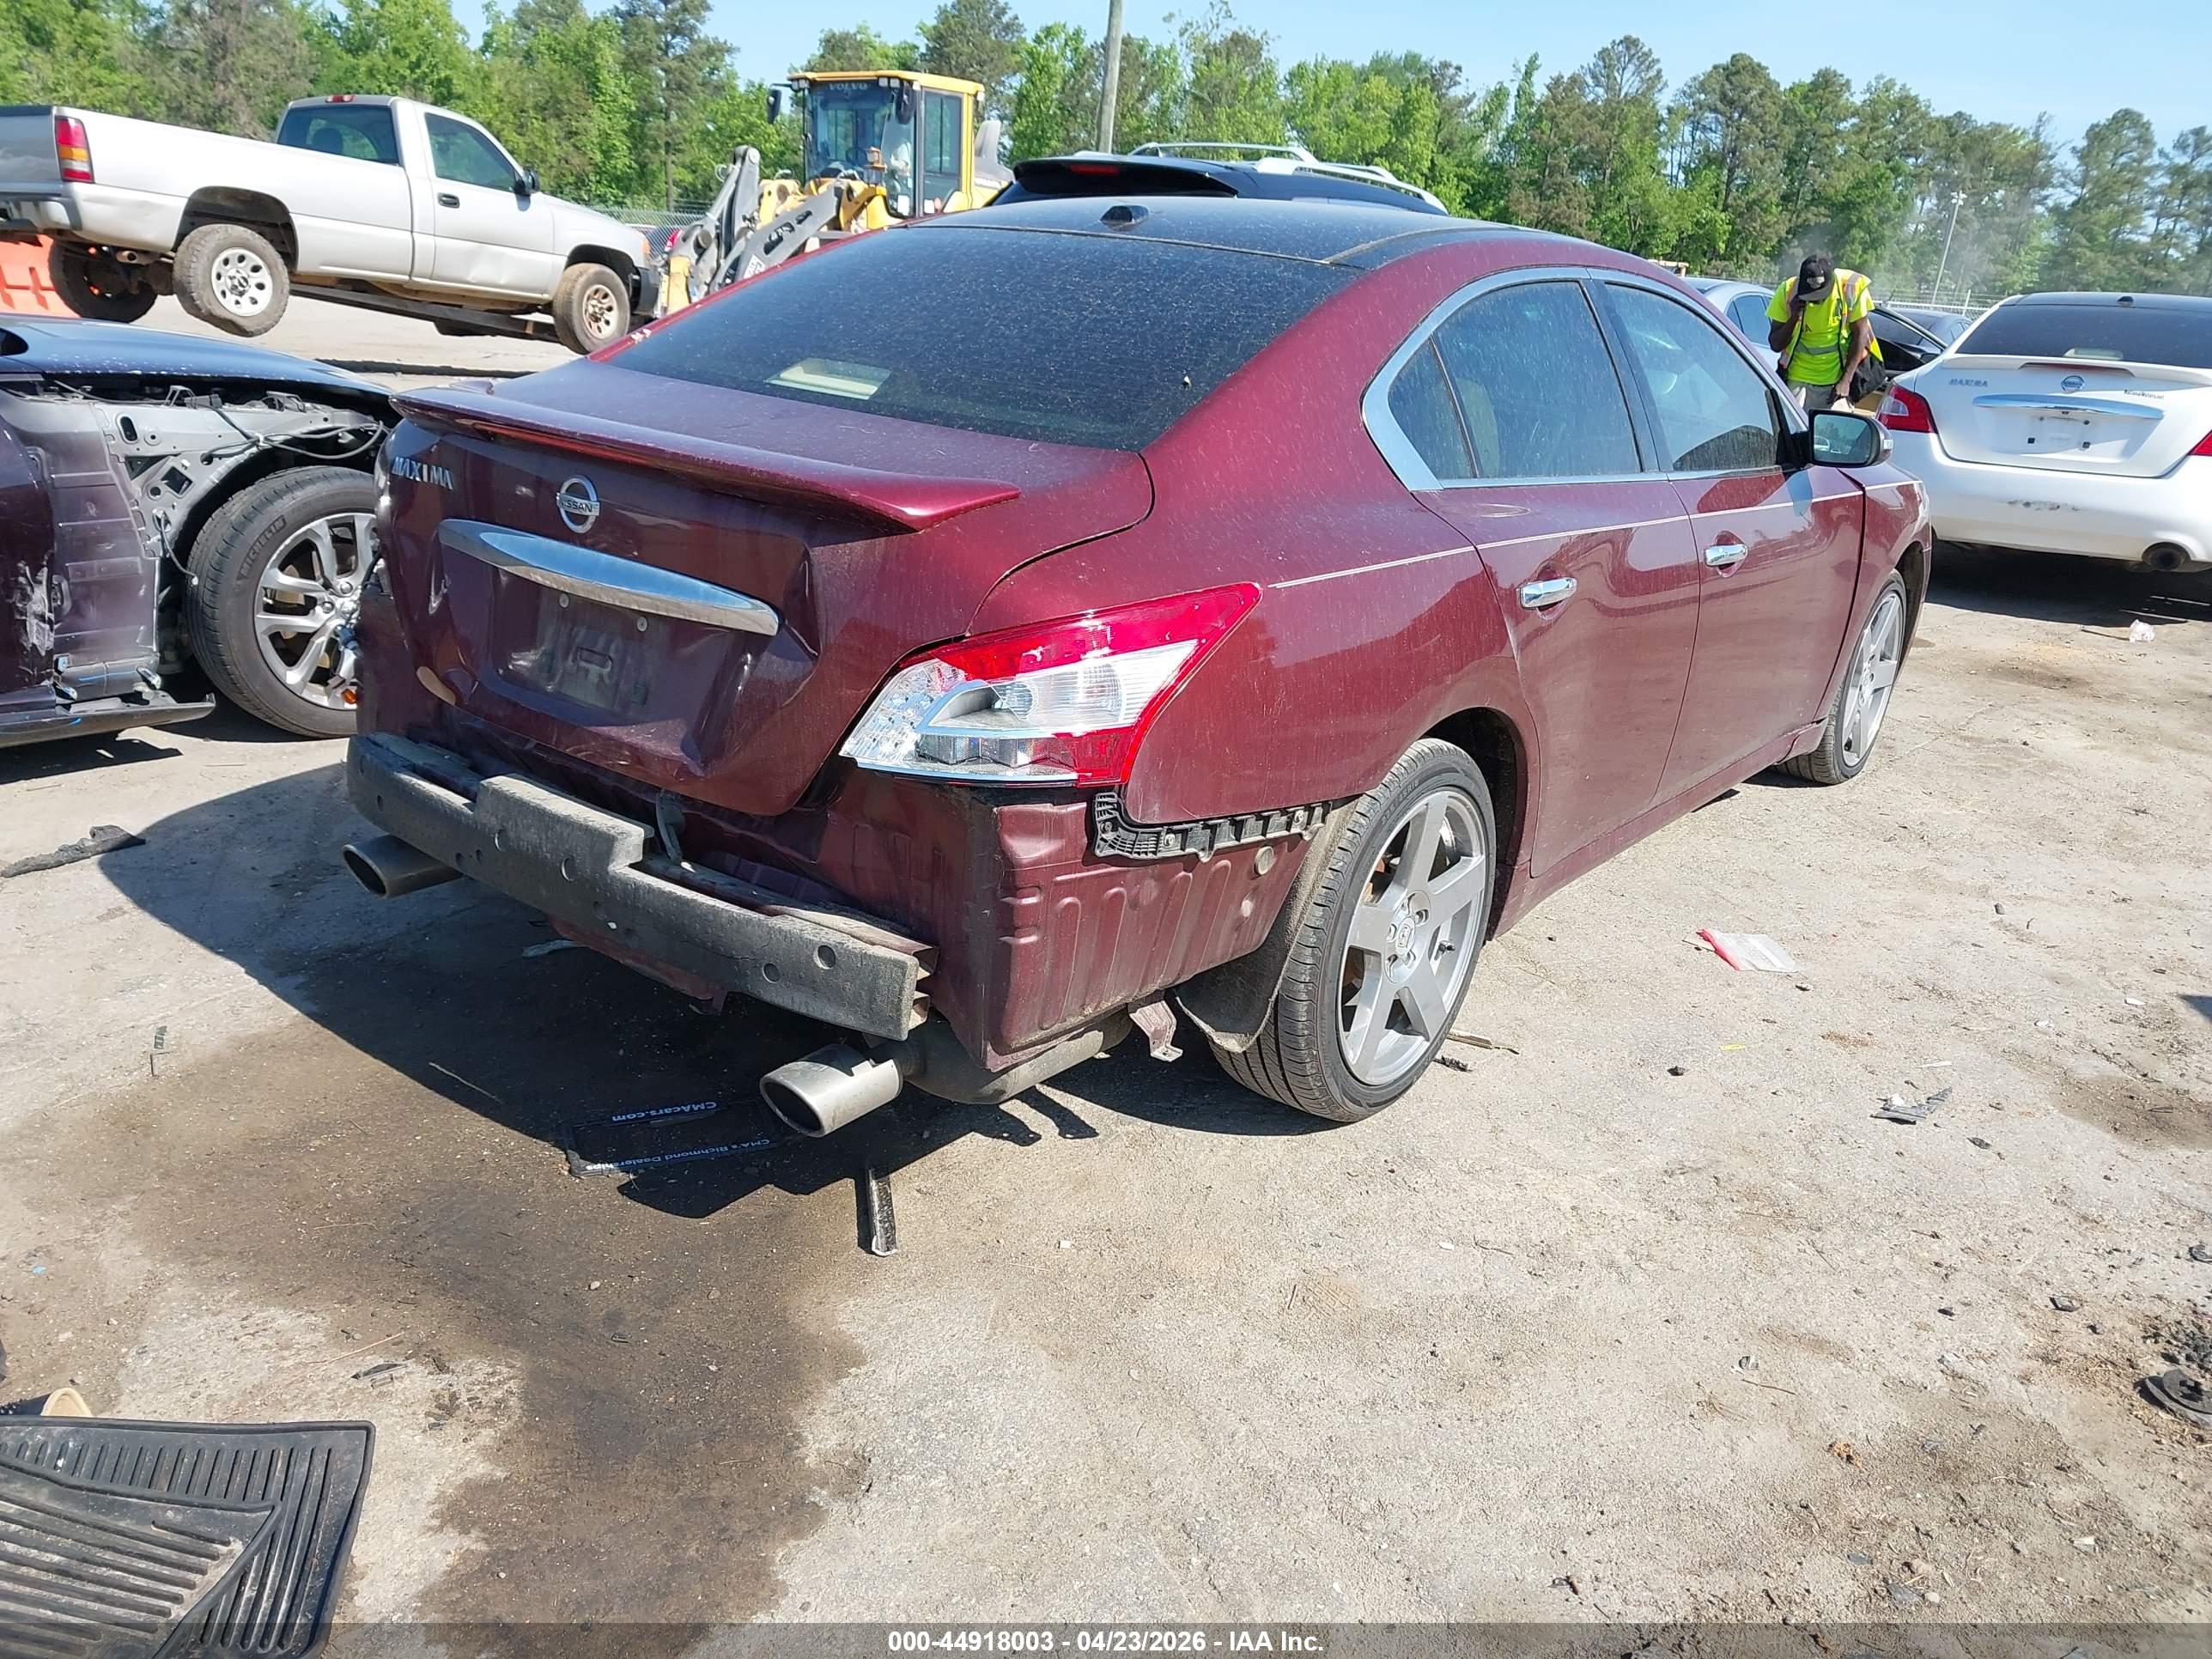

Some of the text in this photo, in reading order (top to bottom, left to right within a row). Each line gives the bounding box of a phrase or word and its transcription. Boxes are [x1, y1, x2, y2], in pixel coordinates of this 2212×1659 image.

[830, 82, 868, 91] VOLVO
[392, 456, 454, 490] MAXIMA
[240, 515, 285, 576] MICHELIN
[611, 1101, 718, 1121] CMAcars.com
[665, 1146, 729, 1160] Richmond
[730, 1139, 770, 1150] CMA's
